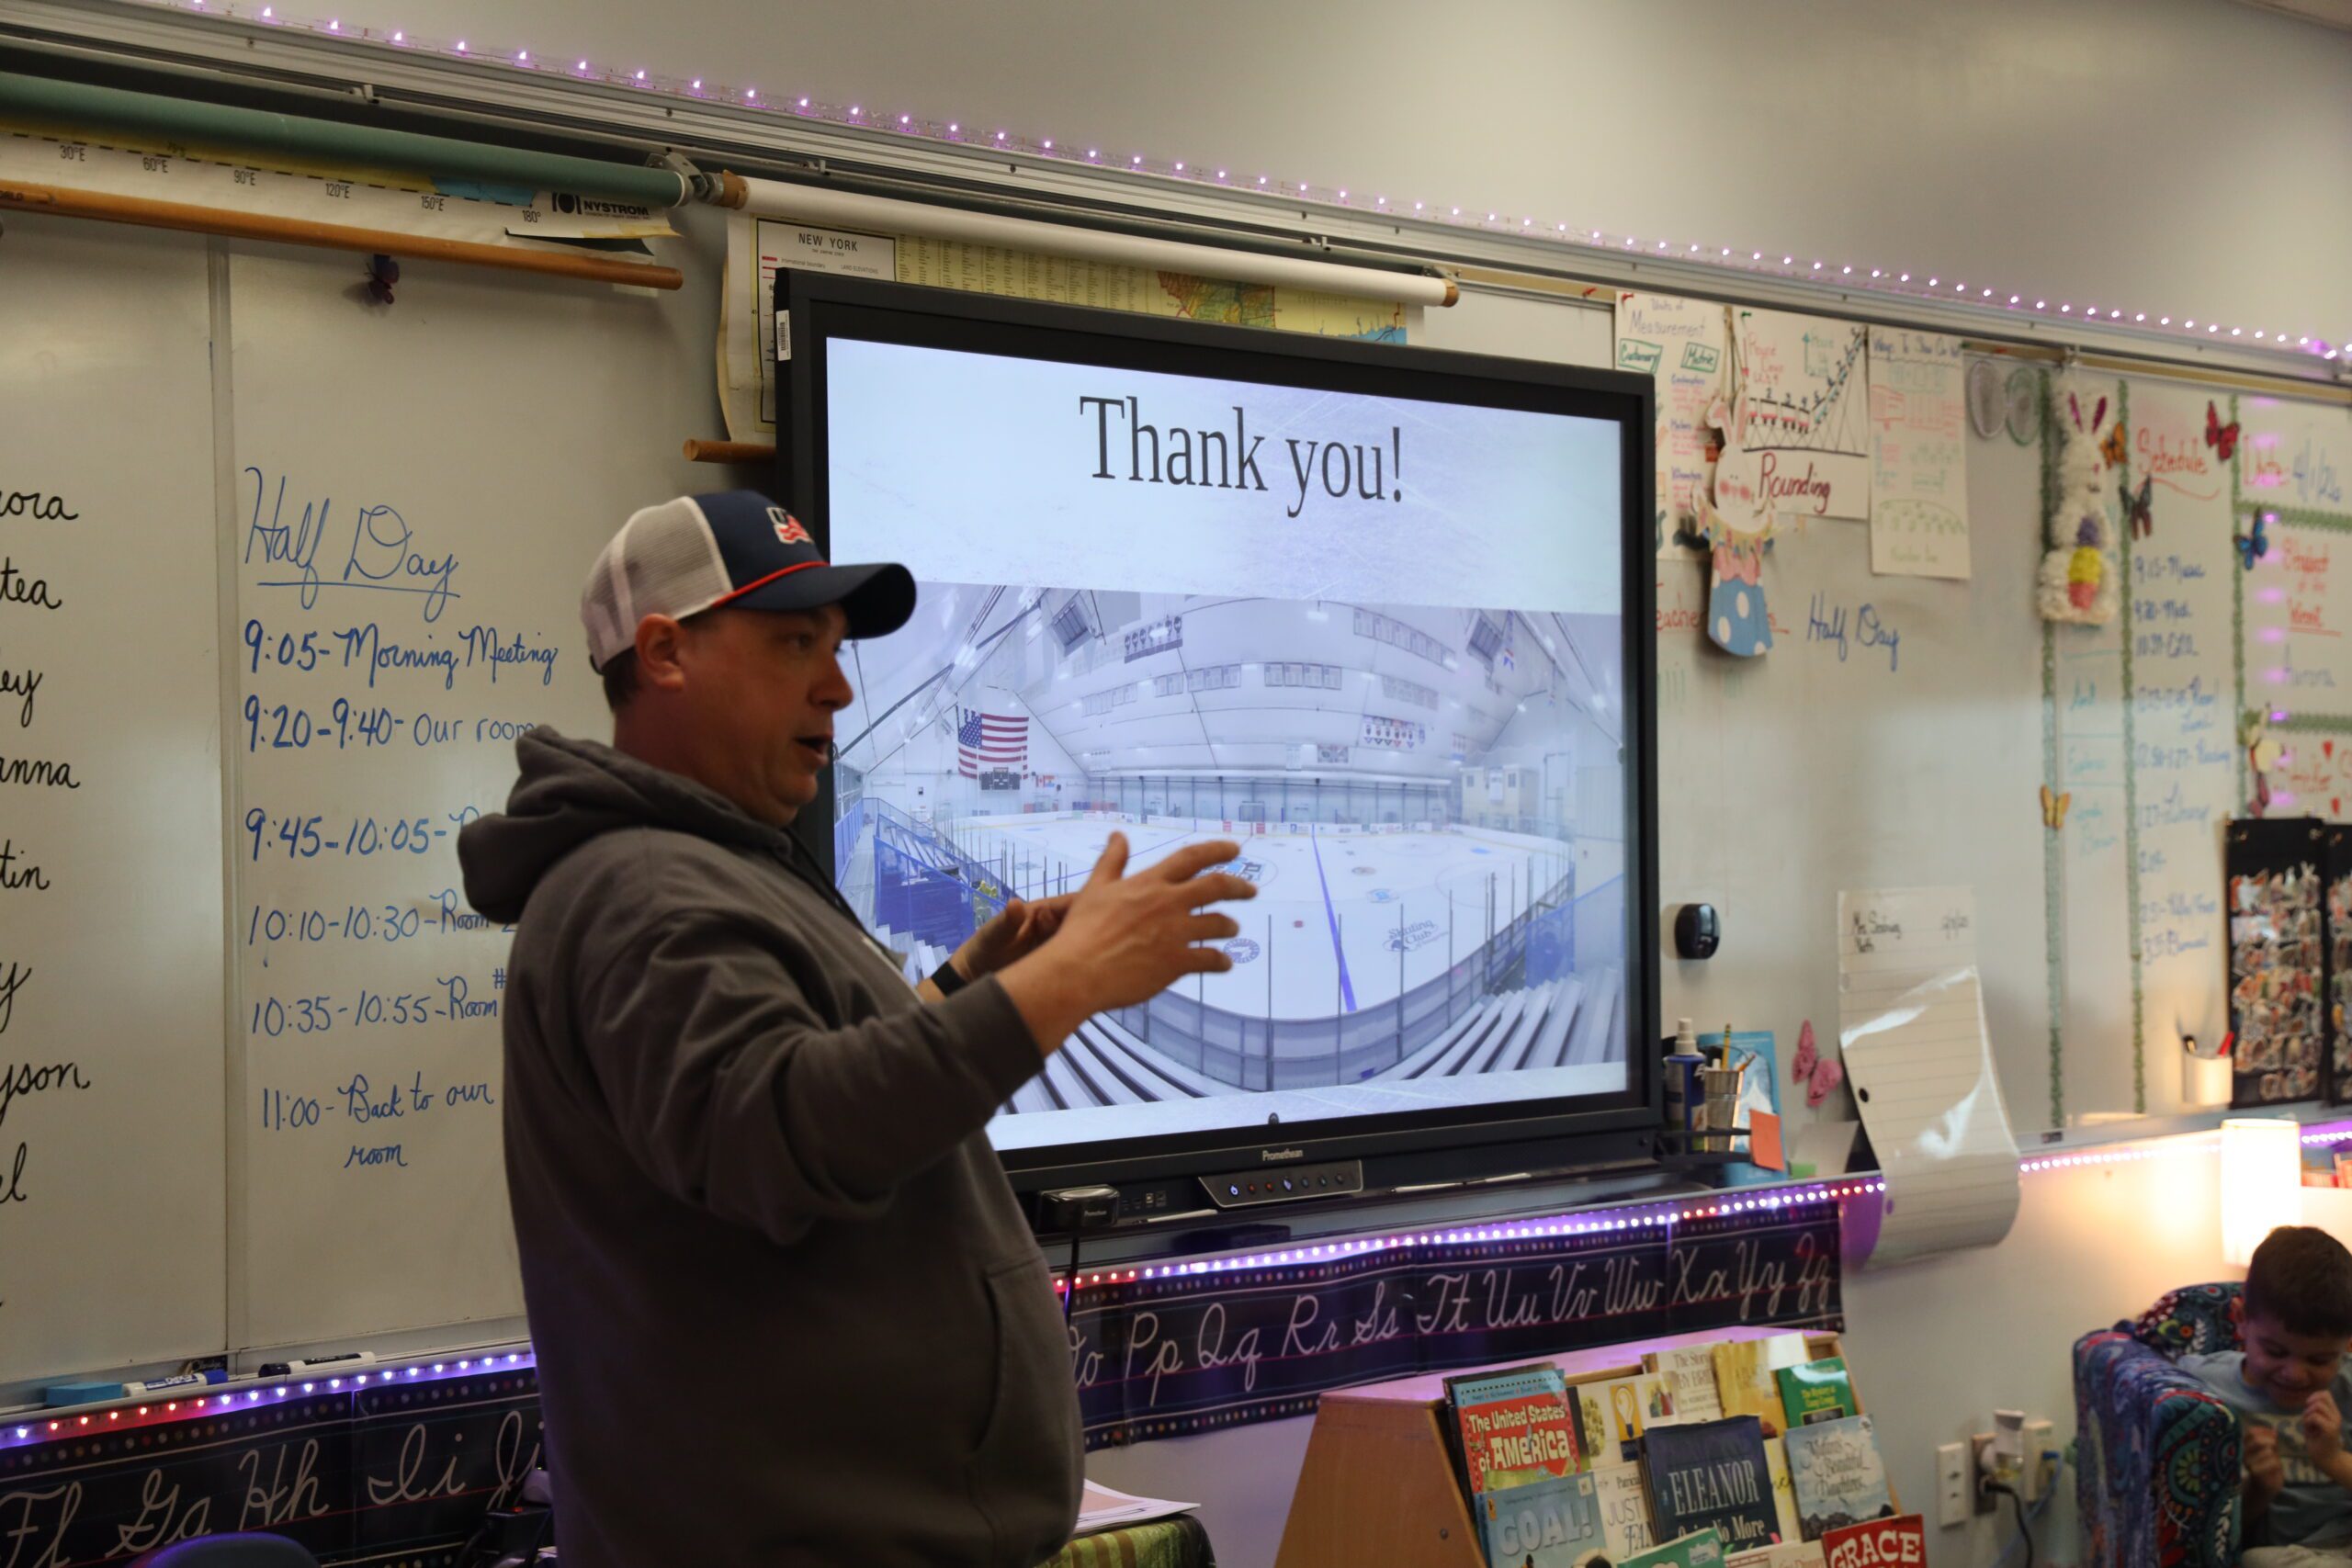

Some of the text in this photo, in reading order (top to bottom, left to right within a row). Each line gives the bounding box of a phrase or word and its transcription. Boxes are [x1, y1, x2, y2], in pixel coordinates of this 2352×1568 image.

[583, 199, 650, 216] NYSTROM
[798, 232, 858, 252] NEW YORK
[1080, 396, 1401, 518] Thank you!
[1758, 451, 1831, 514] Rounding
[244, 467, 459, 623] Half Day
[1806, 589, 1849, 662] Half
[1855, 602, 1901, 672] Day
[458, 626, 559, 686] Meeting
[413, 713, 463, 747] Our
[410, 1070, 435, 1111] to
[446, 1082, 494, 1107] our
[344, 1144, 408, 1168] room
[1262, 1148, 1304, 1161] Promethean
[1125, 1312, 1183, 1407] Pp
[1197, 1302, 1262, 1393] Qq
[1281, 1293, 1340, 1358] Rr
[1351, 1280, 1399, 1345] Ss
[1416, 1272, 1470, 1334] Tt
[1483, 1268, 1541, 1329] Uu
[1548, 1261, 1599, 1323] Vv
[1604, 1256, 1664, 1315] Ww
[1671, 1245, 1731, 1305] Xx
[1736, 1240, 1788, 1321] Yy
[1794, 1232, 1832, 1313] Zz
[1469, 1403, 1567, 1434] The United States
[1478, 1451, 1491, 1472] of
[237, 1438, 331, 1532] Hh
[1668, 1459, 1760, 1517] ELEANOR
[1606, 1495, 1641, 1526] JUST
[1731, 1514, 1765, 1541] More
[1829, 1529, 1922, 1568] GRACE
